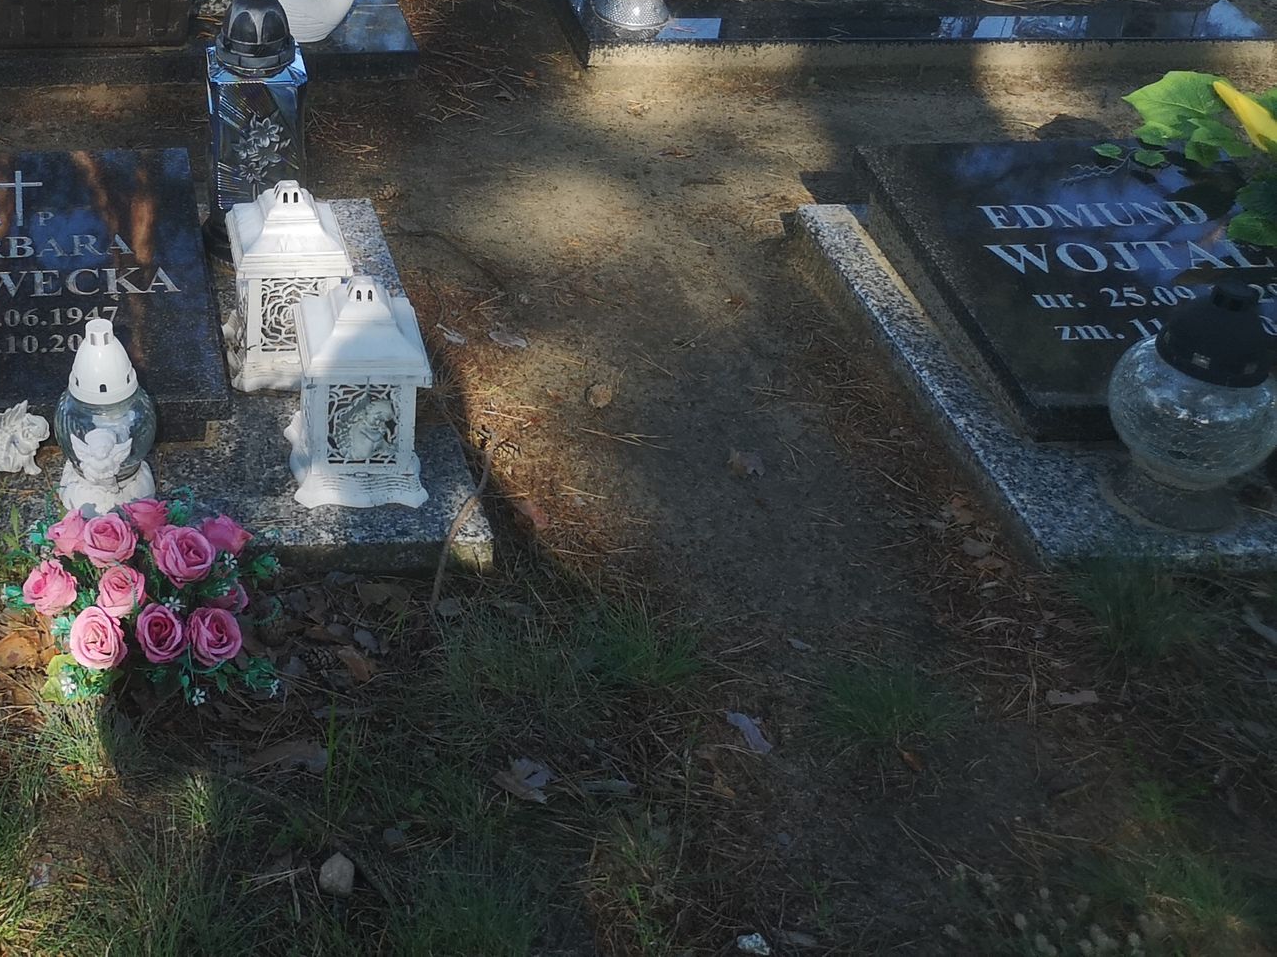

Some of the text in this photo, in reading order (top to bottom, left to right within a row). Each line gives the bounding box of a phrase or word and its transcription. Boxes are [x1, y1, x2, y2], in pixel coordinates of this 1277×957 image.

[977, 200, 1209, 230] EDMUND
[1031, 292, 1087, 310] ur.
[1054, 323, 1126, 341] zm.
